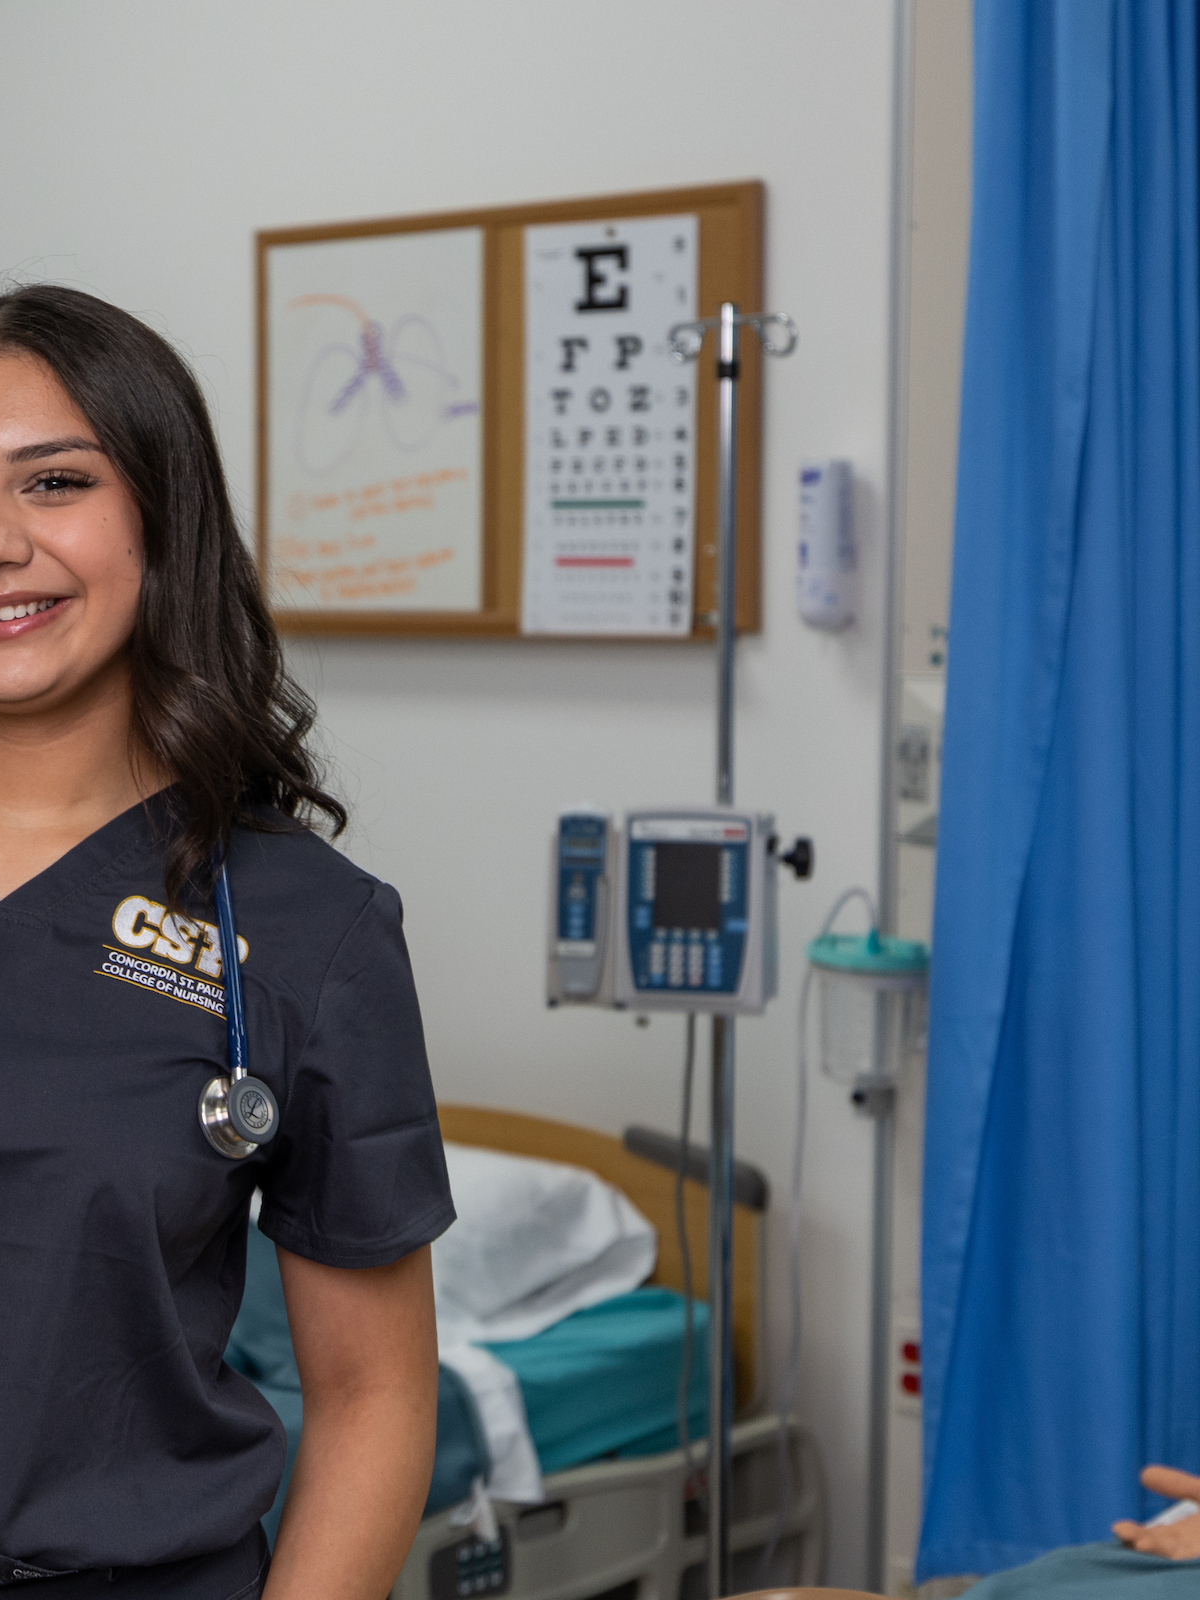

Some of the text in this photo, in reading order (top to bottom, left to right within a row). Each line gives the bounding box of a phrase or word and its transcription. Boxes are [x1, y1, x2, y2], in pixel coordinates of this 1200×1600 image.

[574, 244, 629, 314] E
[614, 334, 644, 371] P
[550, 385, 651, 415] T O Z
[102, 962, 224, 1014] COLLEGE OF NURSING
[108, 951, 225, 1002] CONCORDIA ST. PAUL
